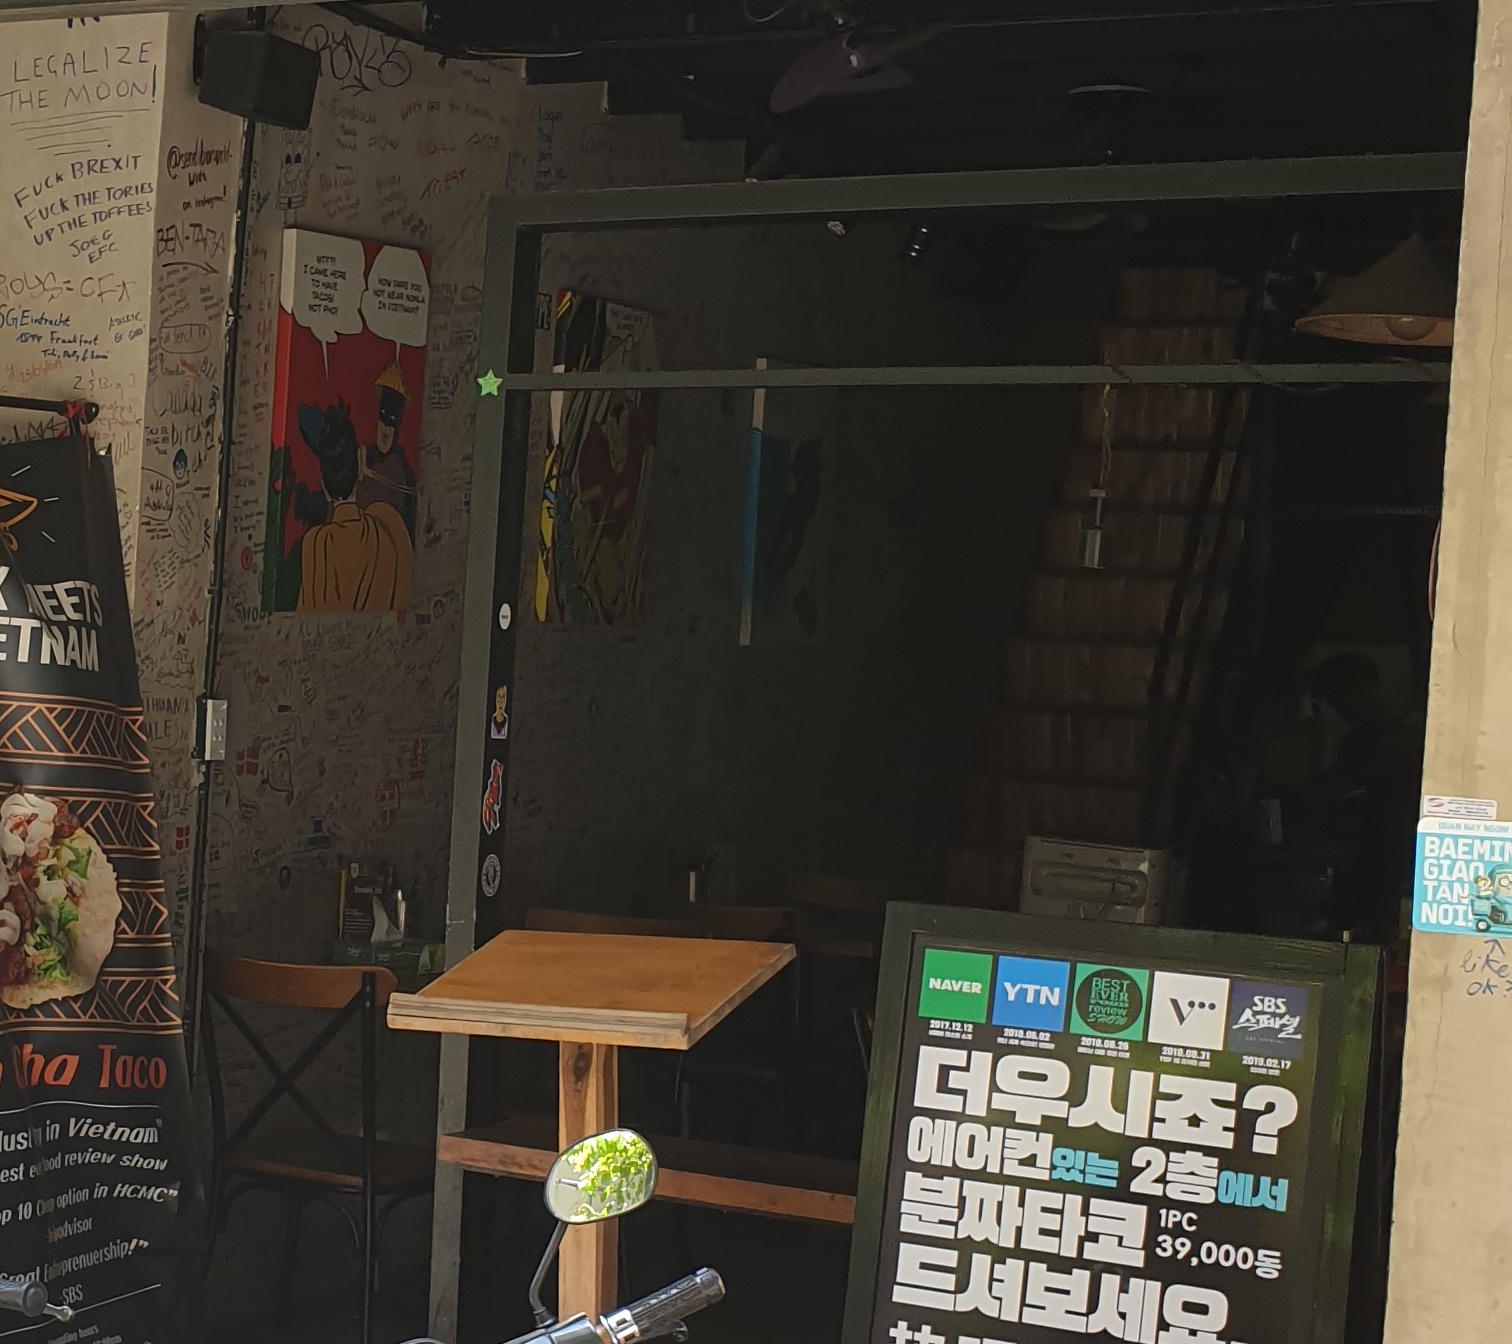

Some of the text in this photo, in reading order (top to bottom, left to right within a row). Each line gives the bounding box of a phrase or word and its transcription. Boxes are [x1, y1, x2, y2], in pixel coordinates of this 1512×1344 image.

[14, 42, 153, 83] LEGALIZE
[0, 65, 158, 114] THE MOON!
[14, 171, 64, 208] FUCK
[70, 155, 142, 181] BREXIT
[24, 182, 154, 230] FUCK THE TORIES
[32, 202, 153, 247] UP THE TOFFEES
[88, 242, 118, 264] EFC
[1423, 859, 1484, 882] GIAO
[928, 977, 983, 994] NAVER
[1003, 981, 1061, 1006] YTN
[1091, 990, 1129, 1002] EVER
[1092, 977, 1130, 992] BEST
[1088, 1004, 1128, 1017] review
[1253, 995, 1288, 1014] SBS
[98, 1044, 167, 1089] Taco
[913, 1045, 1299, 1156] 더우시죠?
[46, 1119, 60, 1143] in
[64, 1147, 116, 1168] review
[119, 1152, 169, 1171] show
[17, 1198, 33, 1221] 10
[56, 1184, 89, 1212] option
[93, 1183, 109, 1201] in
[899, 1171, 1148, 1268] 분짜타코
[1158, 1208, 1198, 1232] 1PC
[1154, 1235, 1283, 1280] 39,000동
